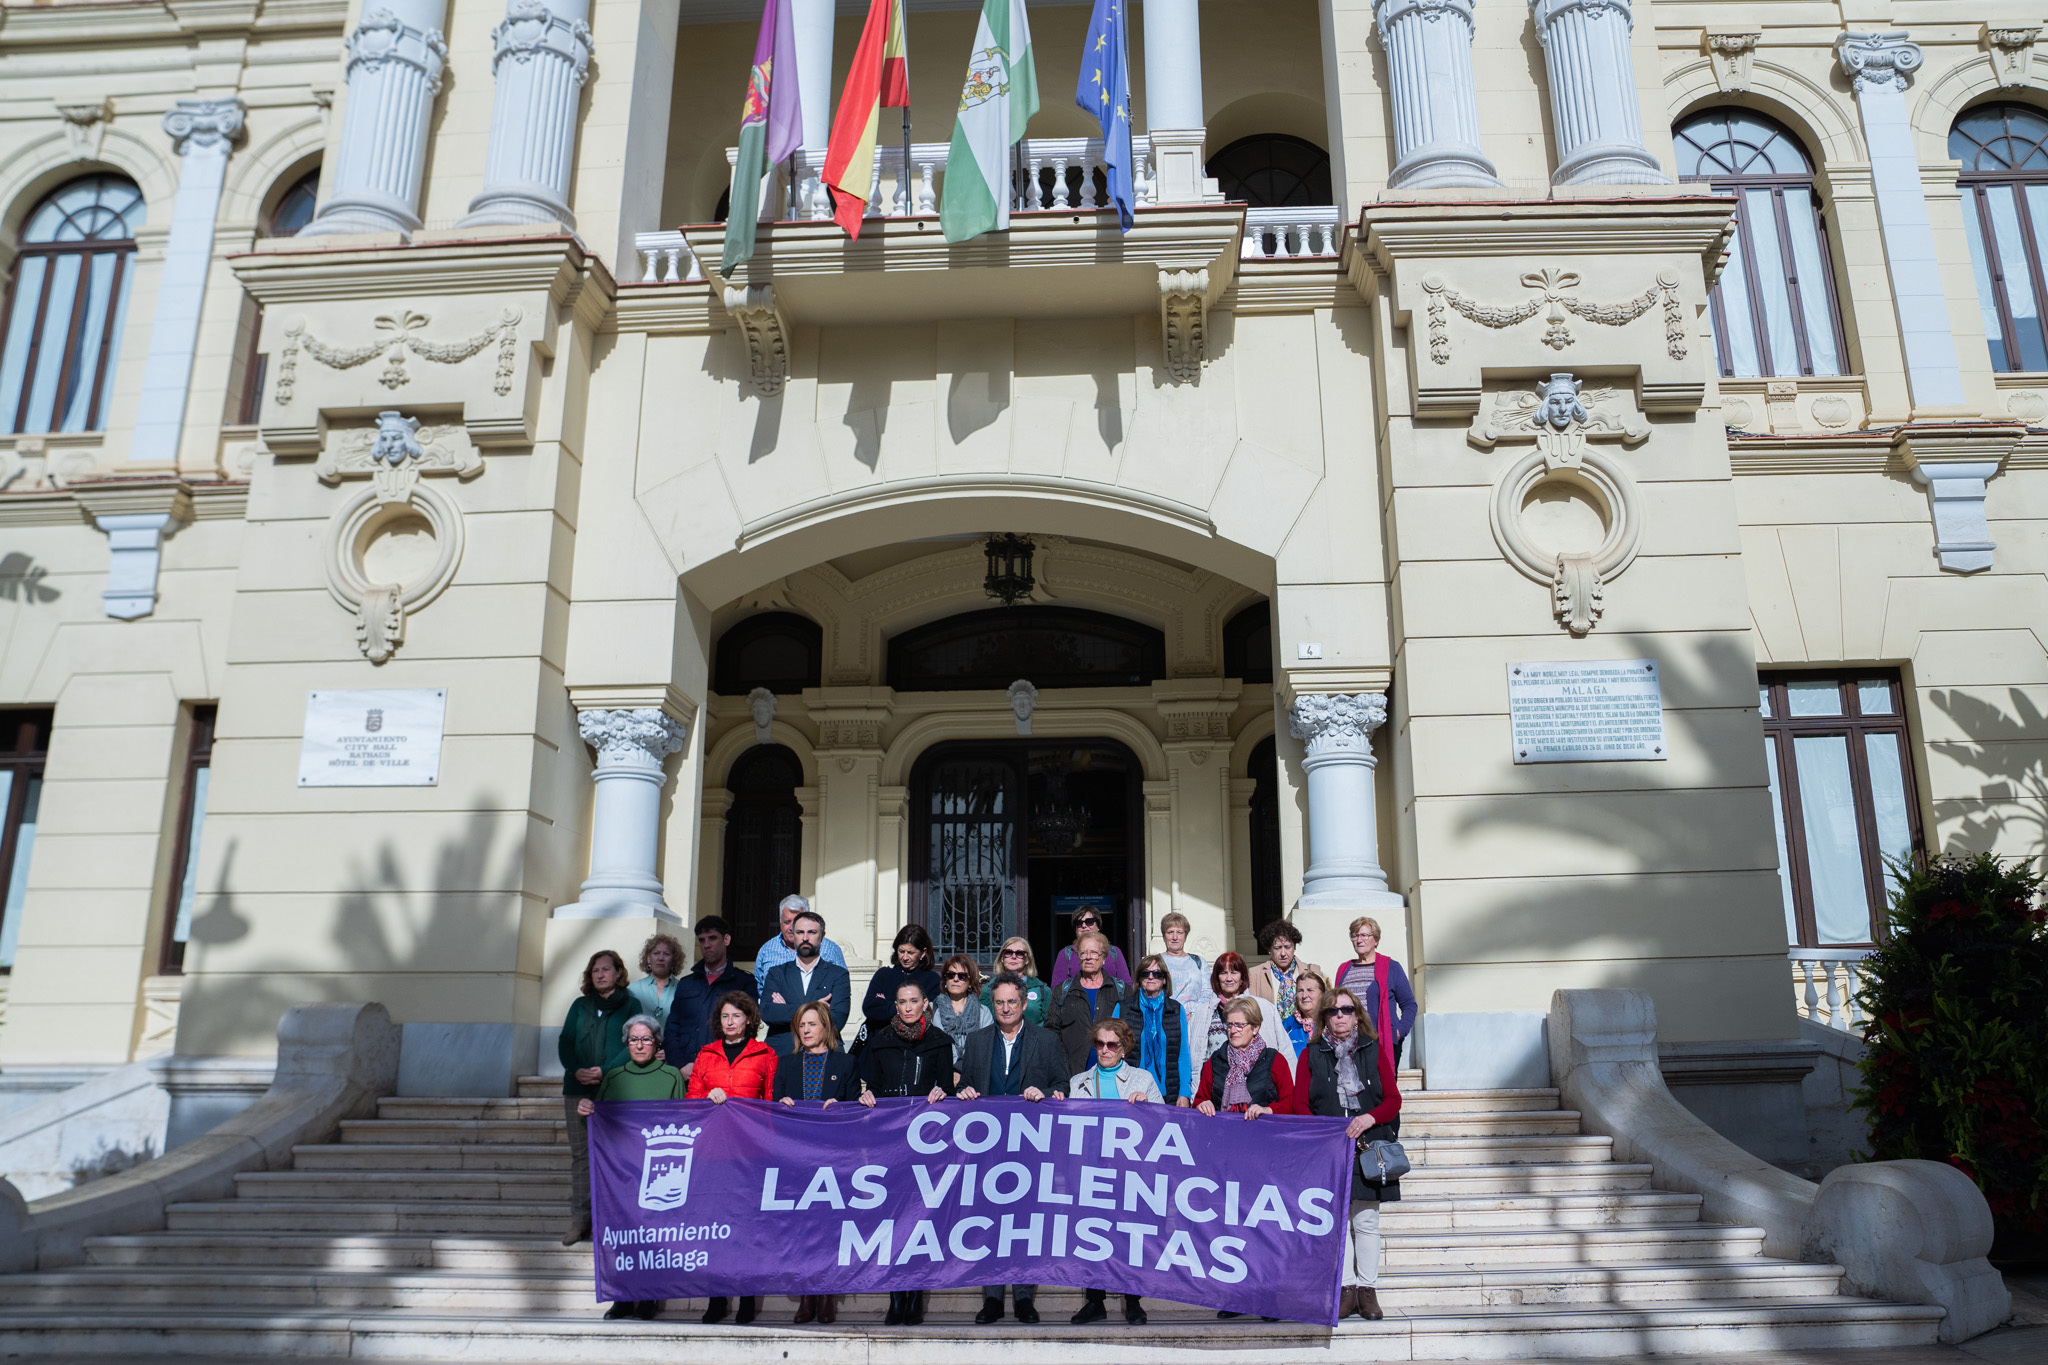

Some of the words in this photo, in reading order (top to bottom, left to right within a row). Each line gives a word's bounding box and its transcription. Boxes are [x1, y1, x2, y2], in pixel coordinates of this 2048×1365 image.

[1306, 645, 1313, 656] 4
[336, 735, 408, 743] AYUNTAMIENTO
[344, 743, 369, 751] CITY
[373, 743, 397, 751] HALL
[349, 751, 391, 759] RATHAUS
[362, 759, 376, 767] DE
[379, 759, 411, 767] VILLE
[906, 1111, 1196, 1166] CONTRA
[760, 1165, 889, 1211] LAS
[912, 1162, 1335, 1233] VIOLENCIAS
[603, 1221, 732, 1250] Ayuntamiento
[837, 1213, 1248, 1284] MACHISTAS
[615, 1251, 635, 1272] de
[638, 1247, 710, 1273] Málaga
